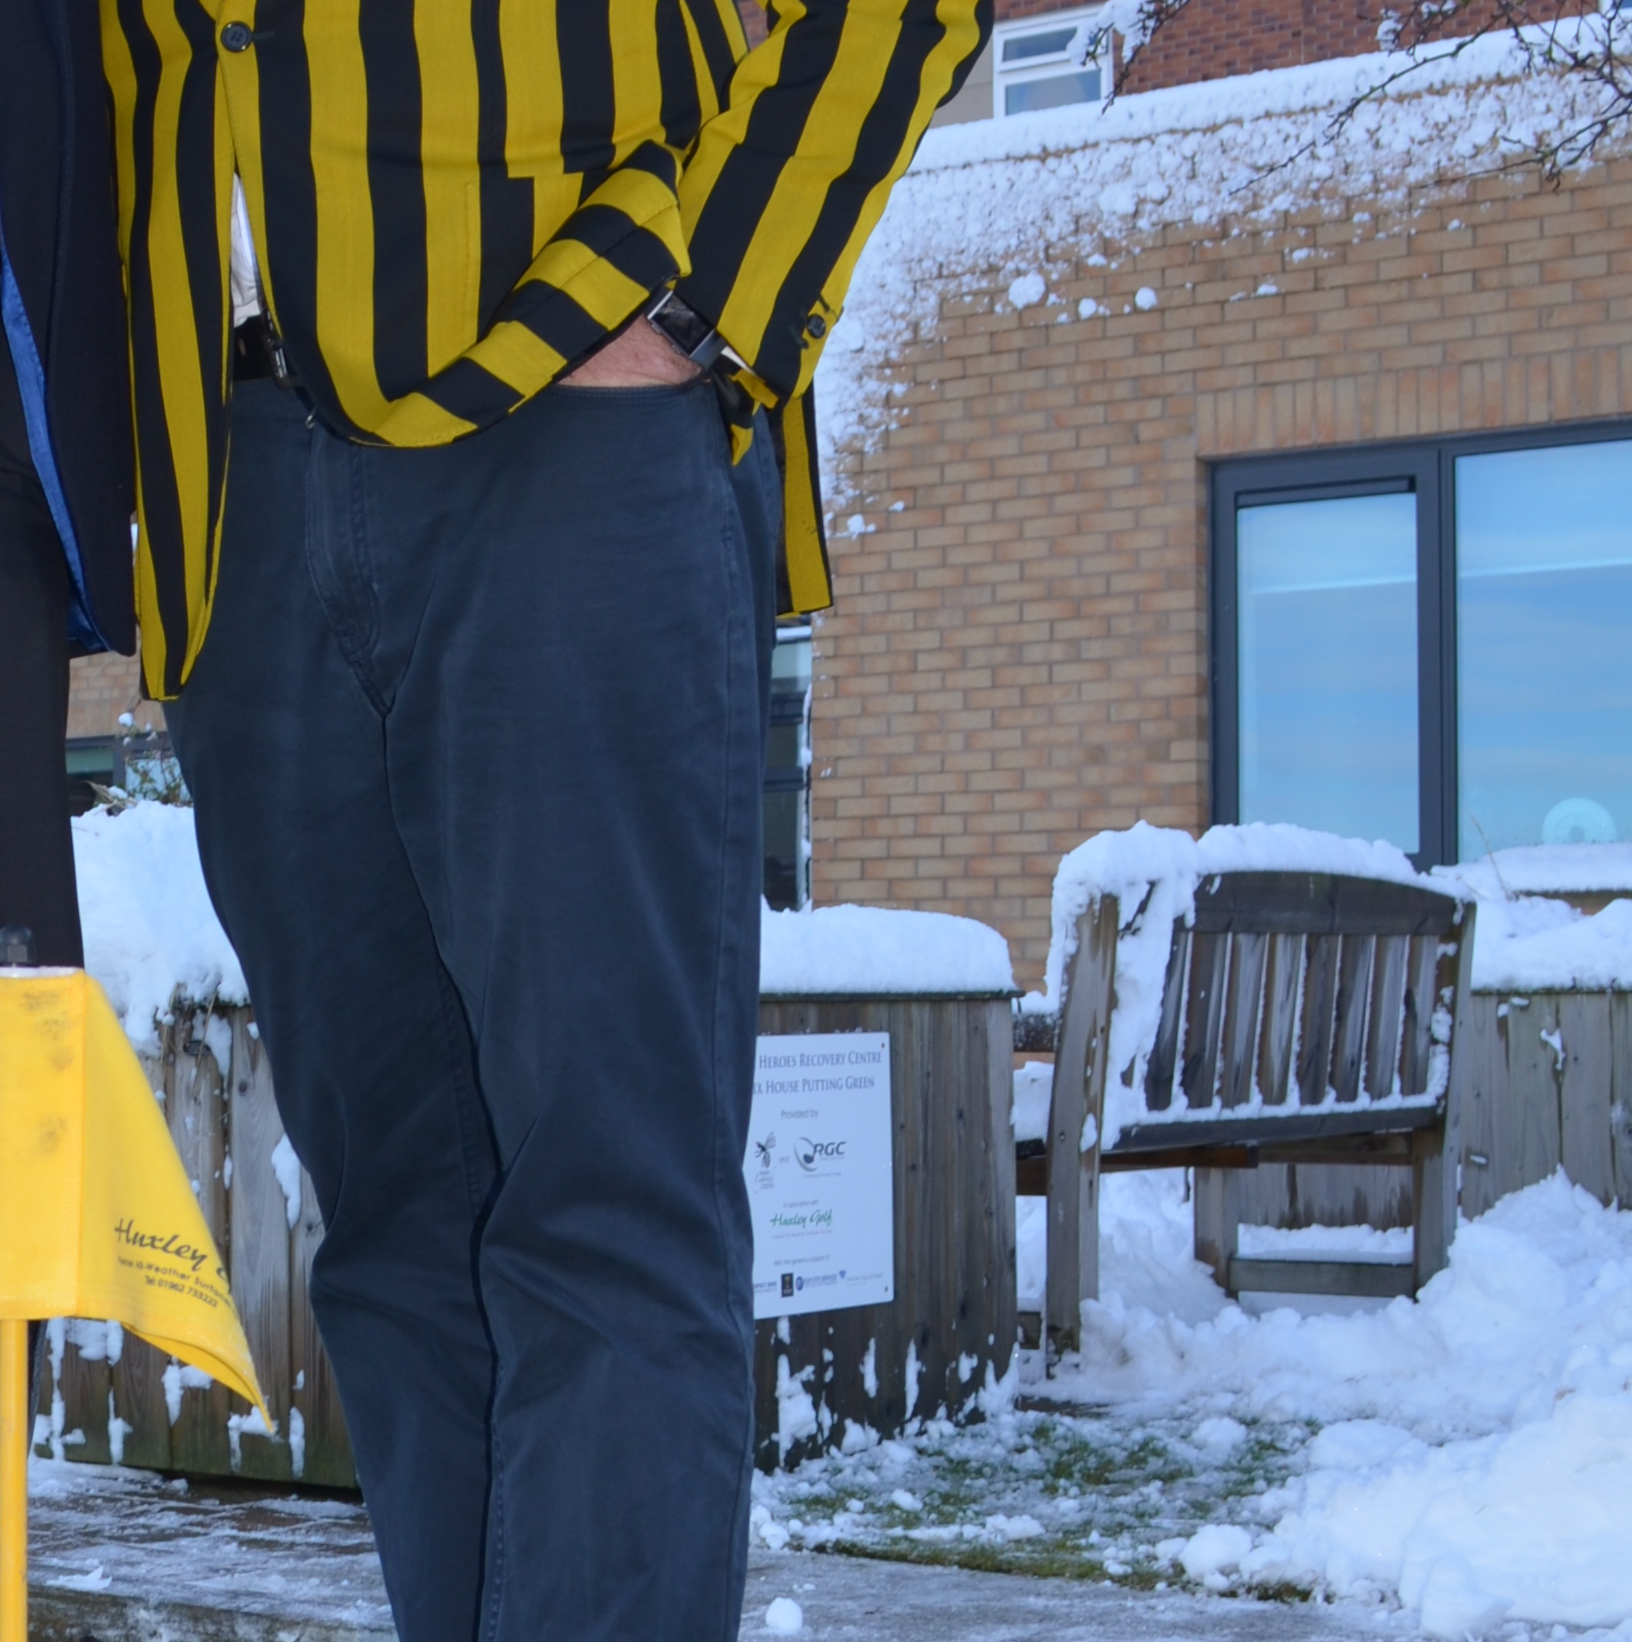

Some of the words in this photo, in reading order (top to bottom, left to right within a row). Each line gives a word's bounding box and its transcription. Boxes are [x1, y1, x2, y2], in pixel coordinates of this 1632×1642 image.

[759, 1054, 797, 1069] HEROES
[799, 1052, 846, 1067] RECOVERY
[848, 1050, 882, 1065] CENTRE
[766, 1079, 799, 1094] HOUSE
[802, 1077, 843, 1092] PUTTING
[845, 1075, 875, 1090] GREEN
[813, 1141, 846, 1156] RGC
[114, 1217, 208, 1272] Huxley
